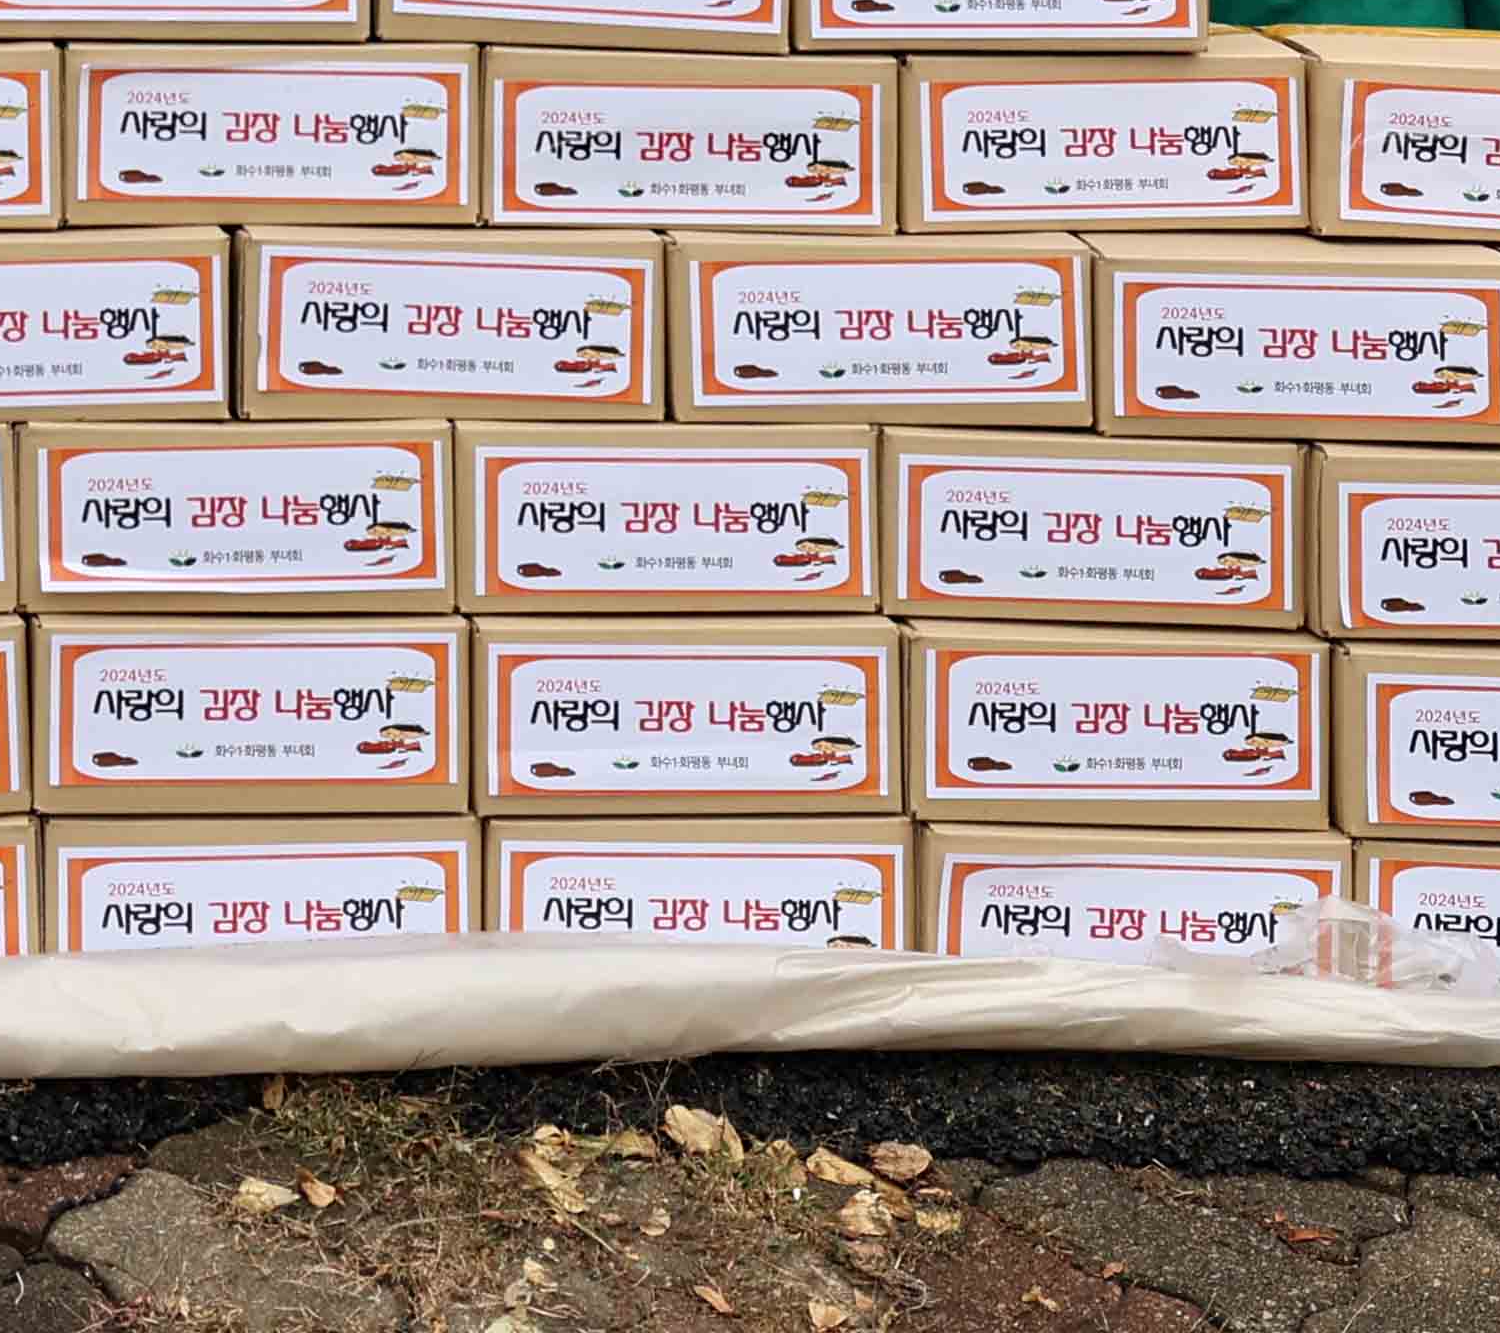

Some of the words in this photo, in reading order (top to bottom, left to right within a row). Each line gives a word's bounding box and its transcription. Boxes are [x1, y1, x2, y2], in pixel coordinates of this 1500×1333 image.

[1389, 111, 1455, 130] 2024년도
[1380, 129, 1468, 164] 사랑의
[535, 677, 605, 694] 2024년도
[528, 698, 621, 731] 사랑의
[635, 701, 696, 732] 김장
